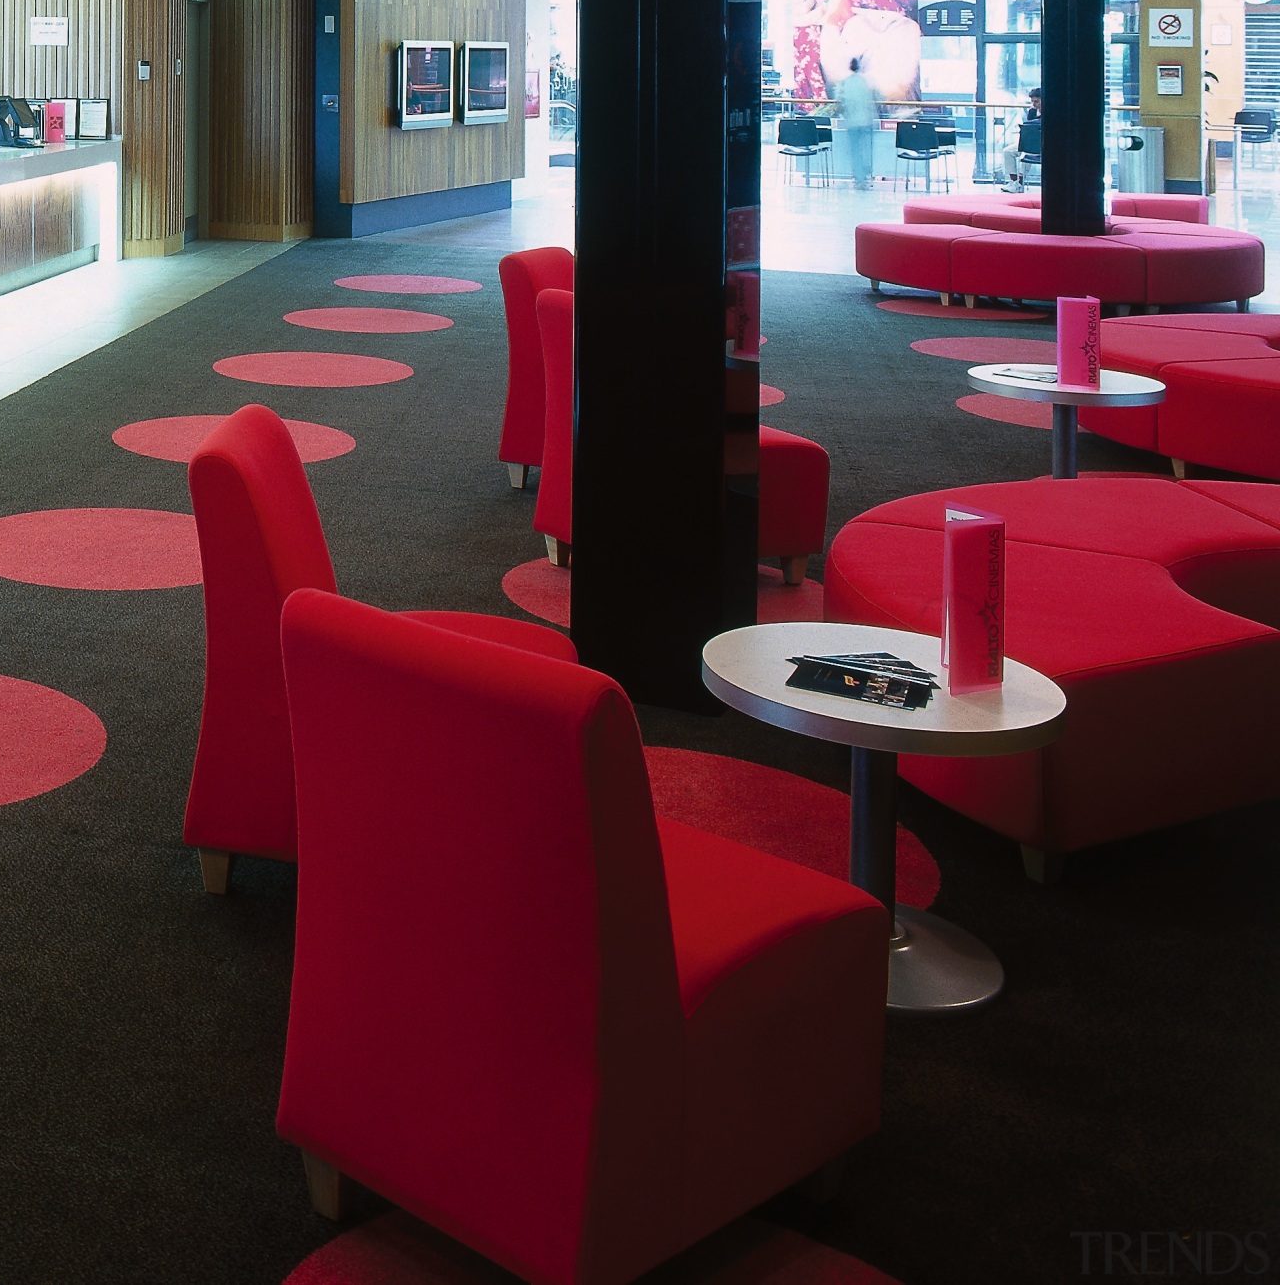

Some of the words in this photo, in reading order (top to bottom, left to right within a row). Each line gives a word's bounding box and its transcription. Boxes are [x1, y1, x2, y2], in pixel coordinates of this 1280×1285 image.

[1088, 305, 1097, 343] CINEMAS
[1088, 355, 1097, 384] RIALTO
[988, 528, 1001, 601] CINEMAS
[988, 623, 1000, 678] RIALTO
